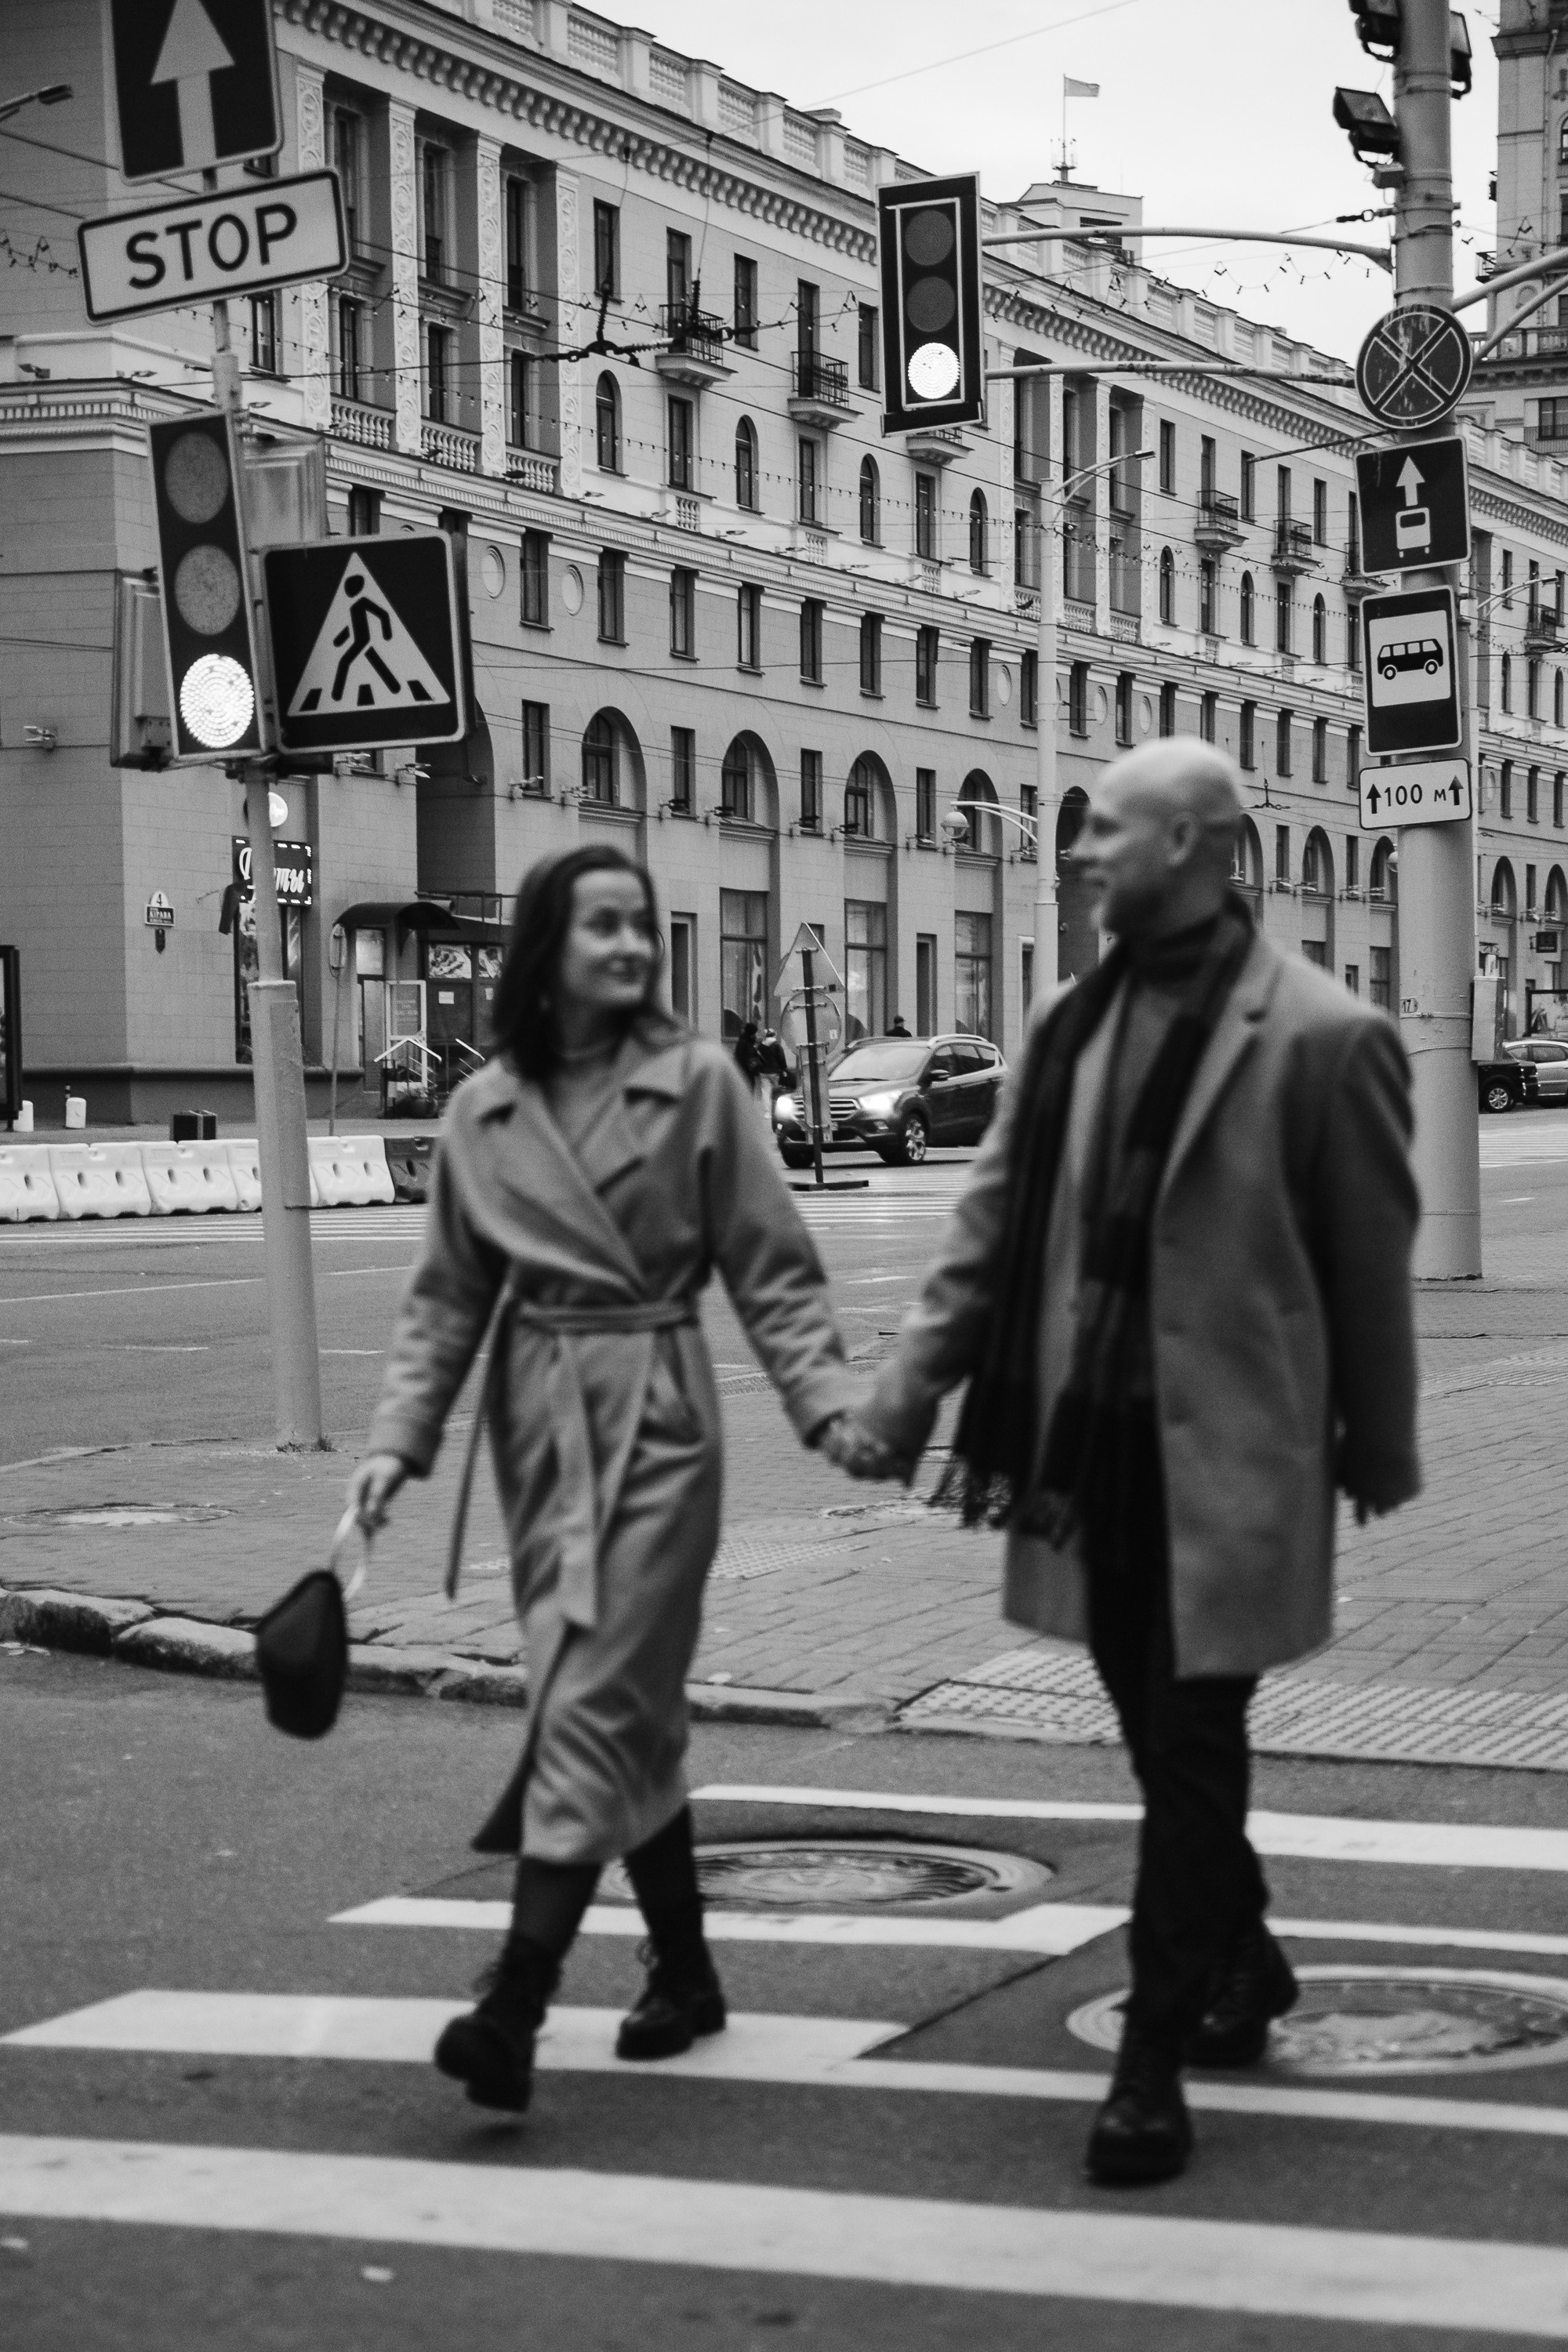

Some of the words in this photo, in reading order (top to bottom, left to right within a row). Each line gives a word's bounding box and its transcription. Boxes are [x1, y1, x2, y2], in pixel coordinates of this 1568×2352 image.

[125, 202, 298, 290] STOP
[1384, 783, 1423, 808] 100
[156, 893, 163, 907] 4
